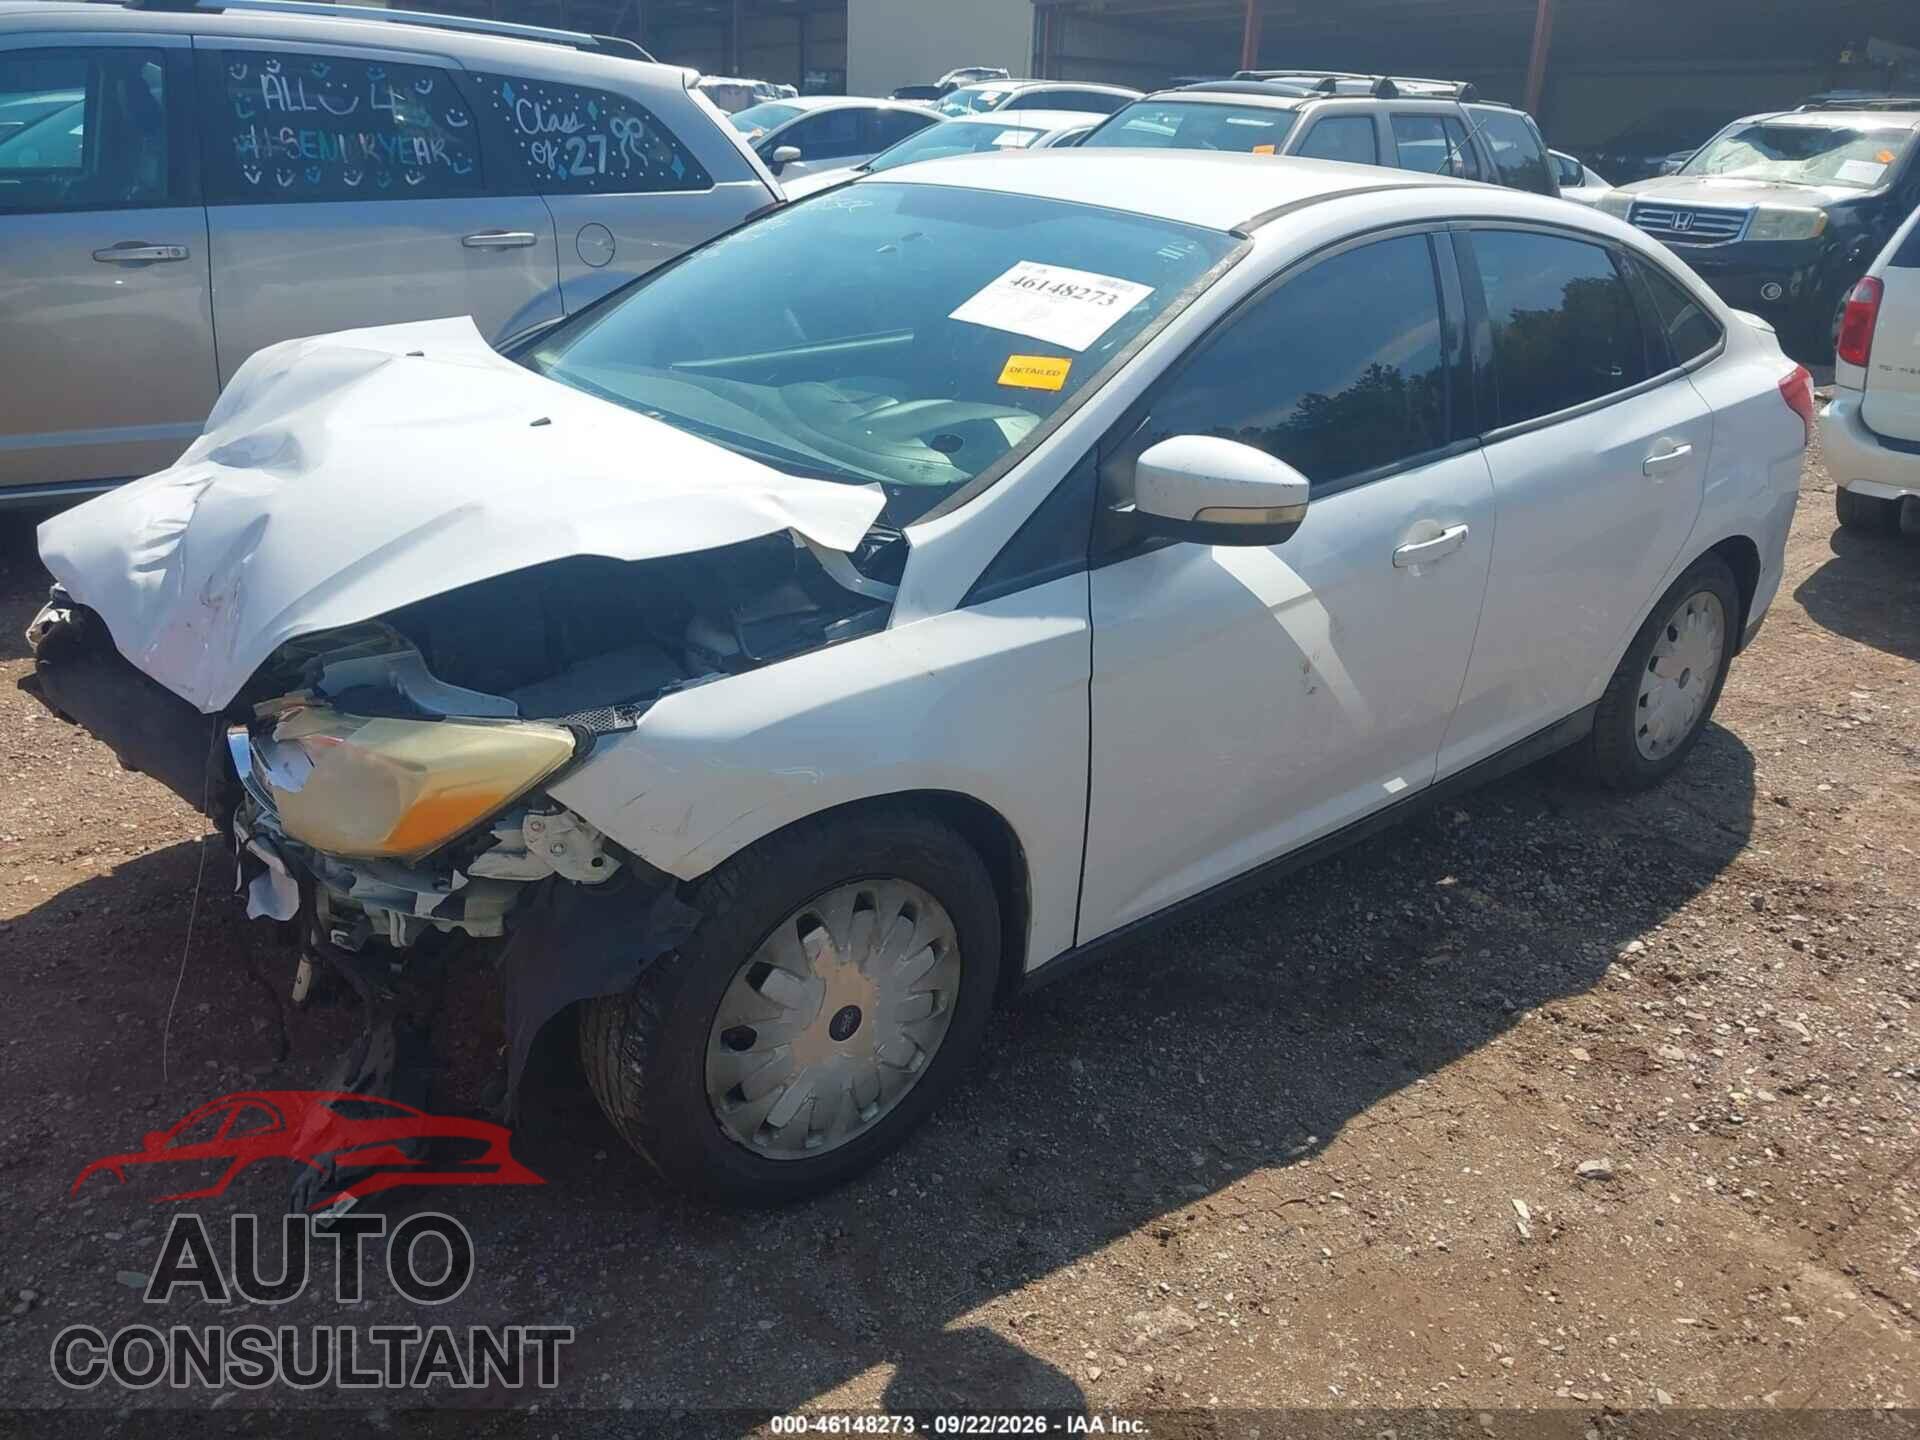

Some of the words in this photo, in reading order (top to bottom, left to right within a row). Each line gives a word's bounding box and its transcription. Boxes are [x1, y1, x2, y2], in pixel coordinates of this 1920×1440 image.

[260, 74, 316, 112] ALL
[515, 98, 585, 135] Class
[531, 140, 559, 171] of
[565, 134, 607, 176] 27
[1009, 274, 1119, 307] 46148273
[1007, 366, 1061, 378] DETAILED
